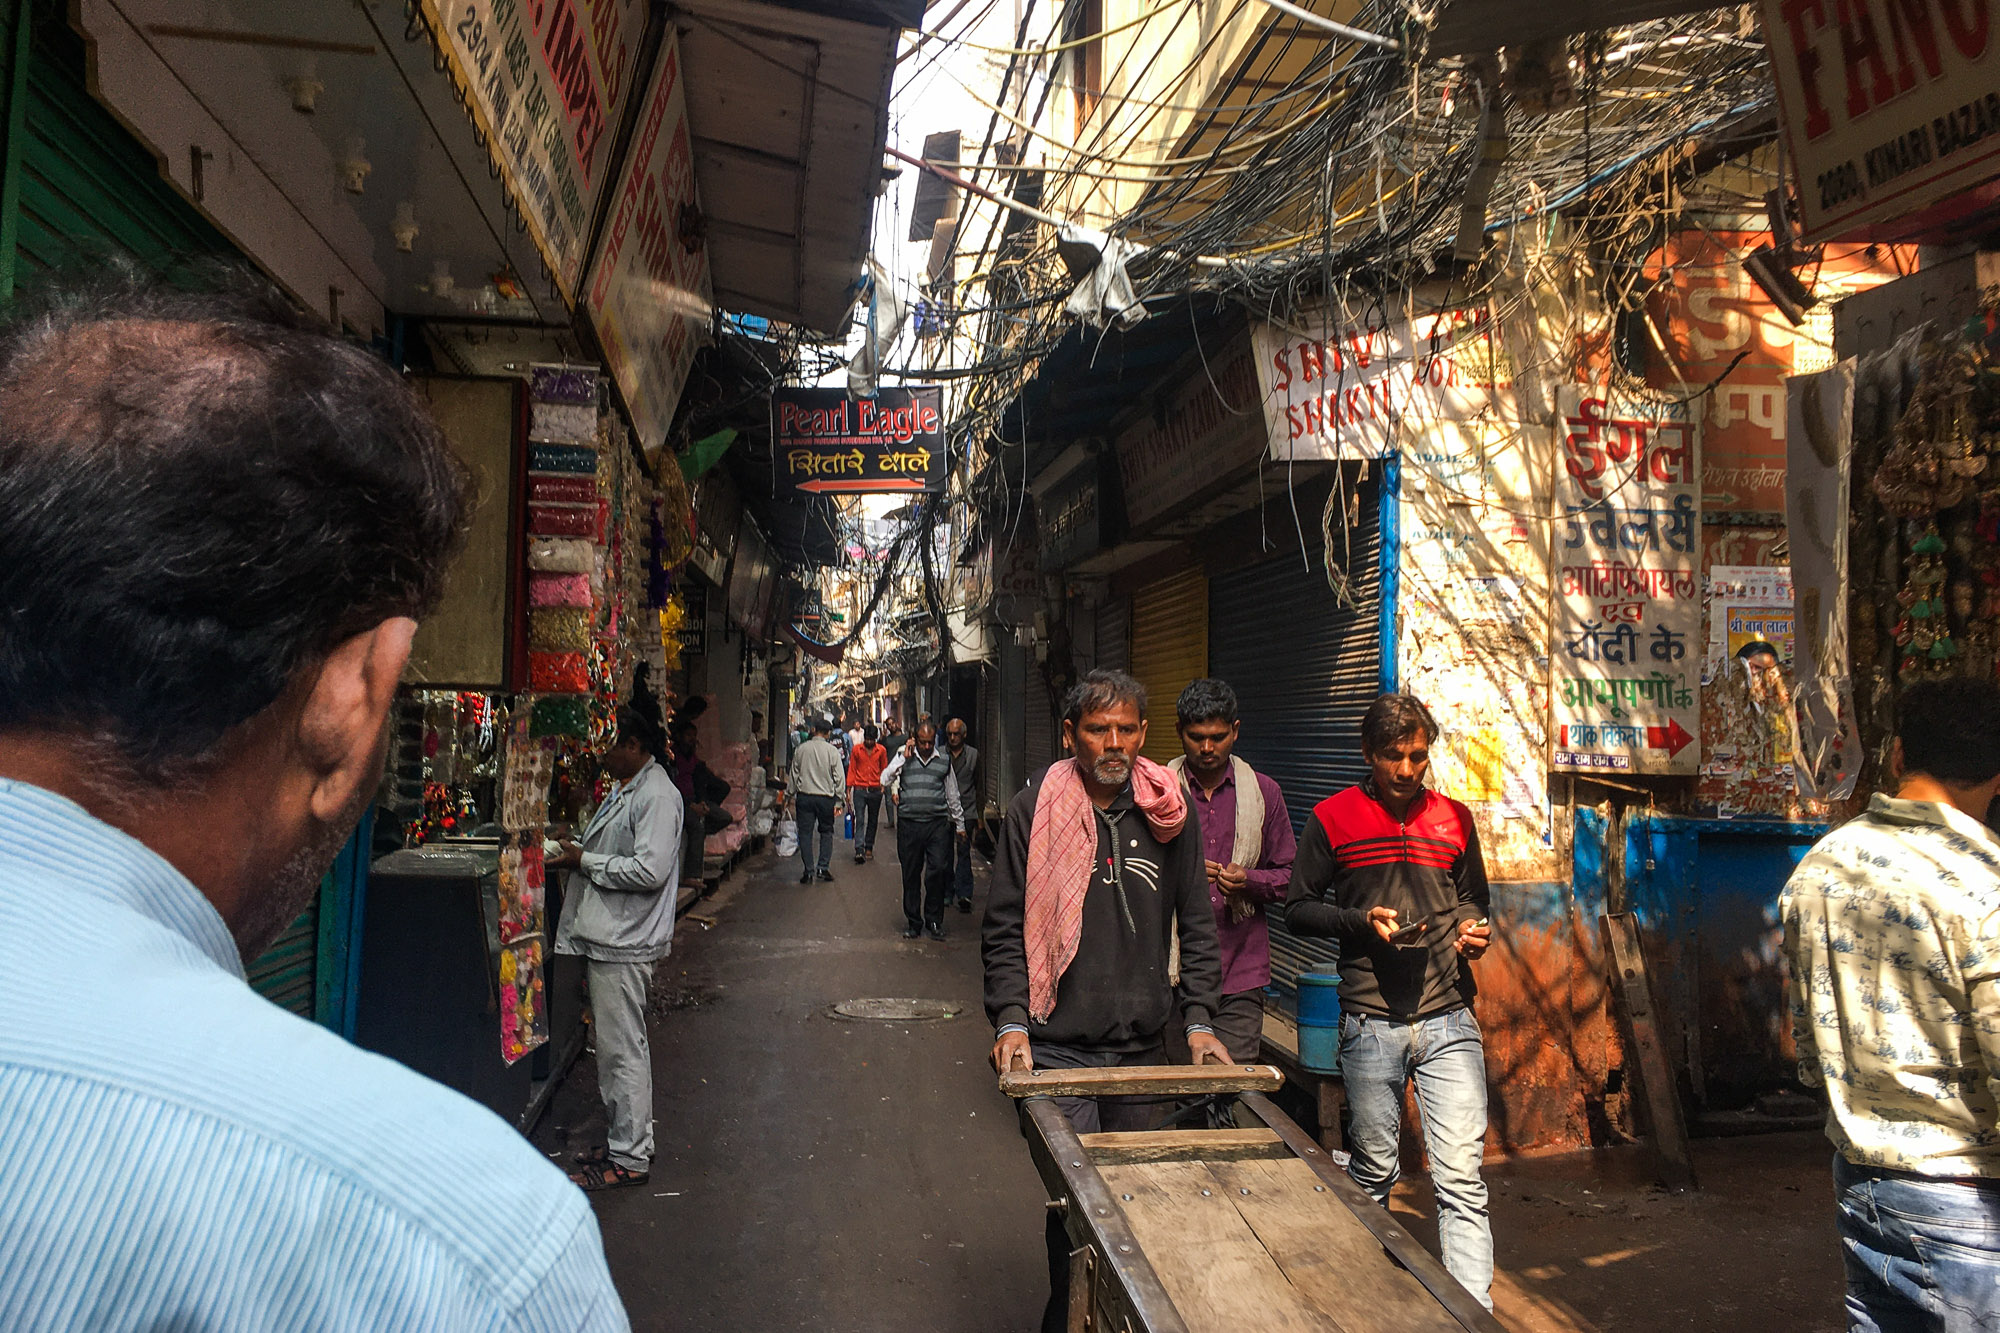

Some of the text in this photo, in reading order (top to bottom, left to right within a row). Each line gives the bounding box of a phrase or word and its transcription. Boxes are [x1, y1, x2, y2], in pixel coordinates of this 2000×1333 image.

[485, 67, 511, 130] KINARI
[524, 70, 550, 138] ZARI
[543, 0, 605, 190] IMPEX
[636, 104, 661, 172] SHREE
[1864, 124, 1934, 189] KINARI
[1273, 325, 1377, 393] SHIV
[779, 398, 939, 444] Pearl Eagle
[1284, 378, 1391, 441] SHAKTI
[787, 445, 932, 476] सितारे वाले
[1565, 397, 1697, 500] ईगल
[1649, 623, 1686, 662] के
[1730, 617, 1743, 633] श्री
[1766, 620, 1789, 633] लाल
[1673, 672, 1694, 710] के
[1555, 752, 1630, 768] राम राम राम राम
[1569, 718, 1598, 748] थोक
